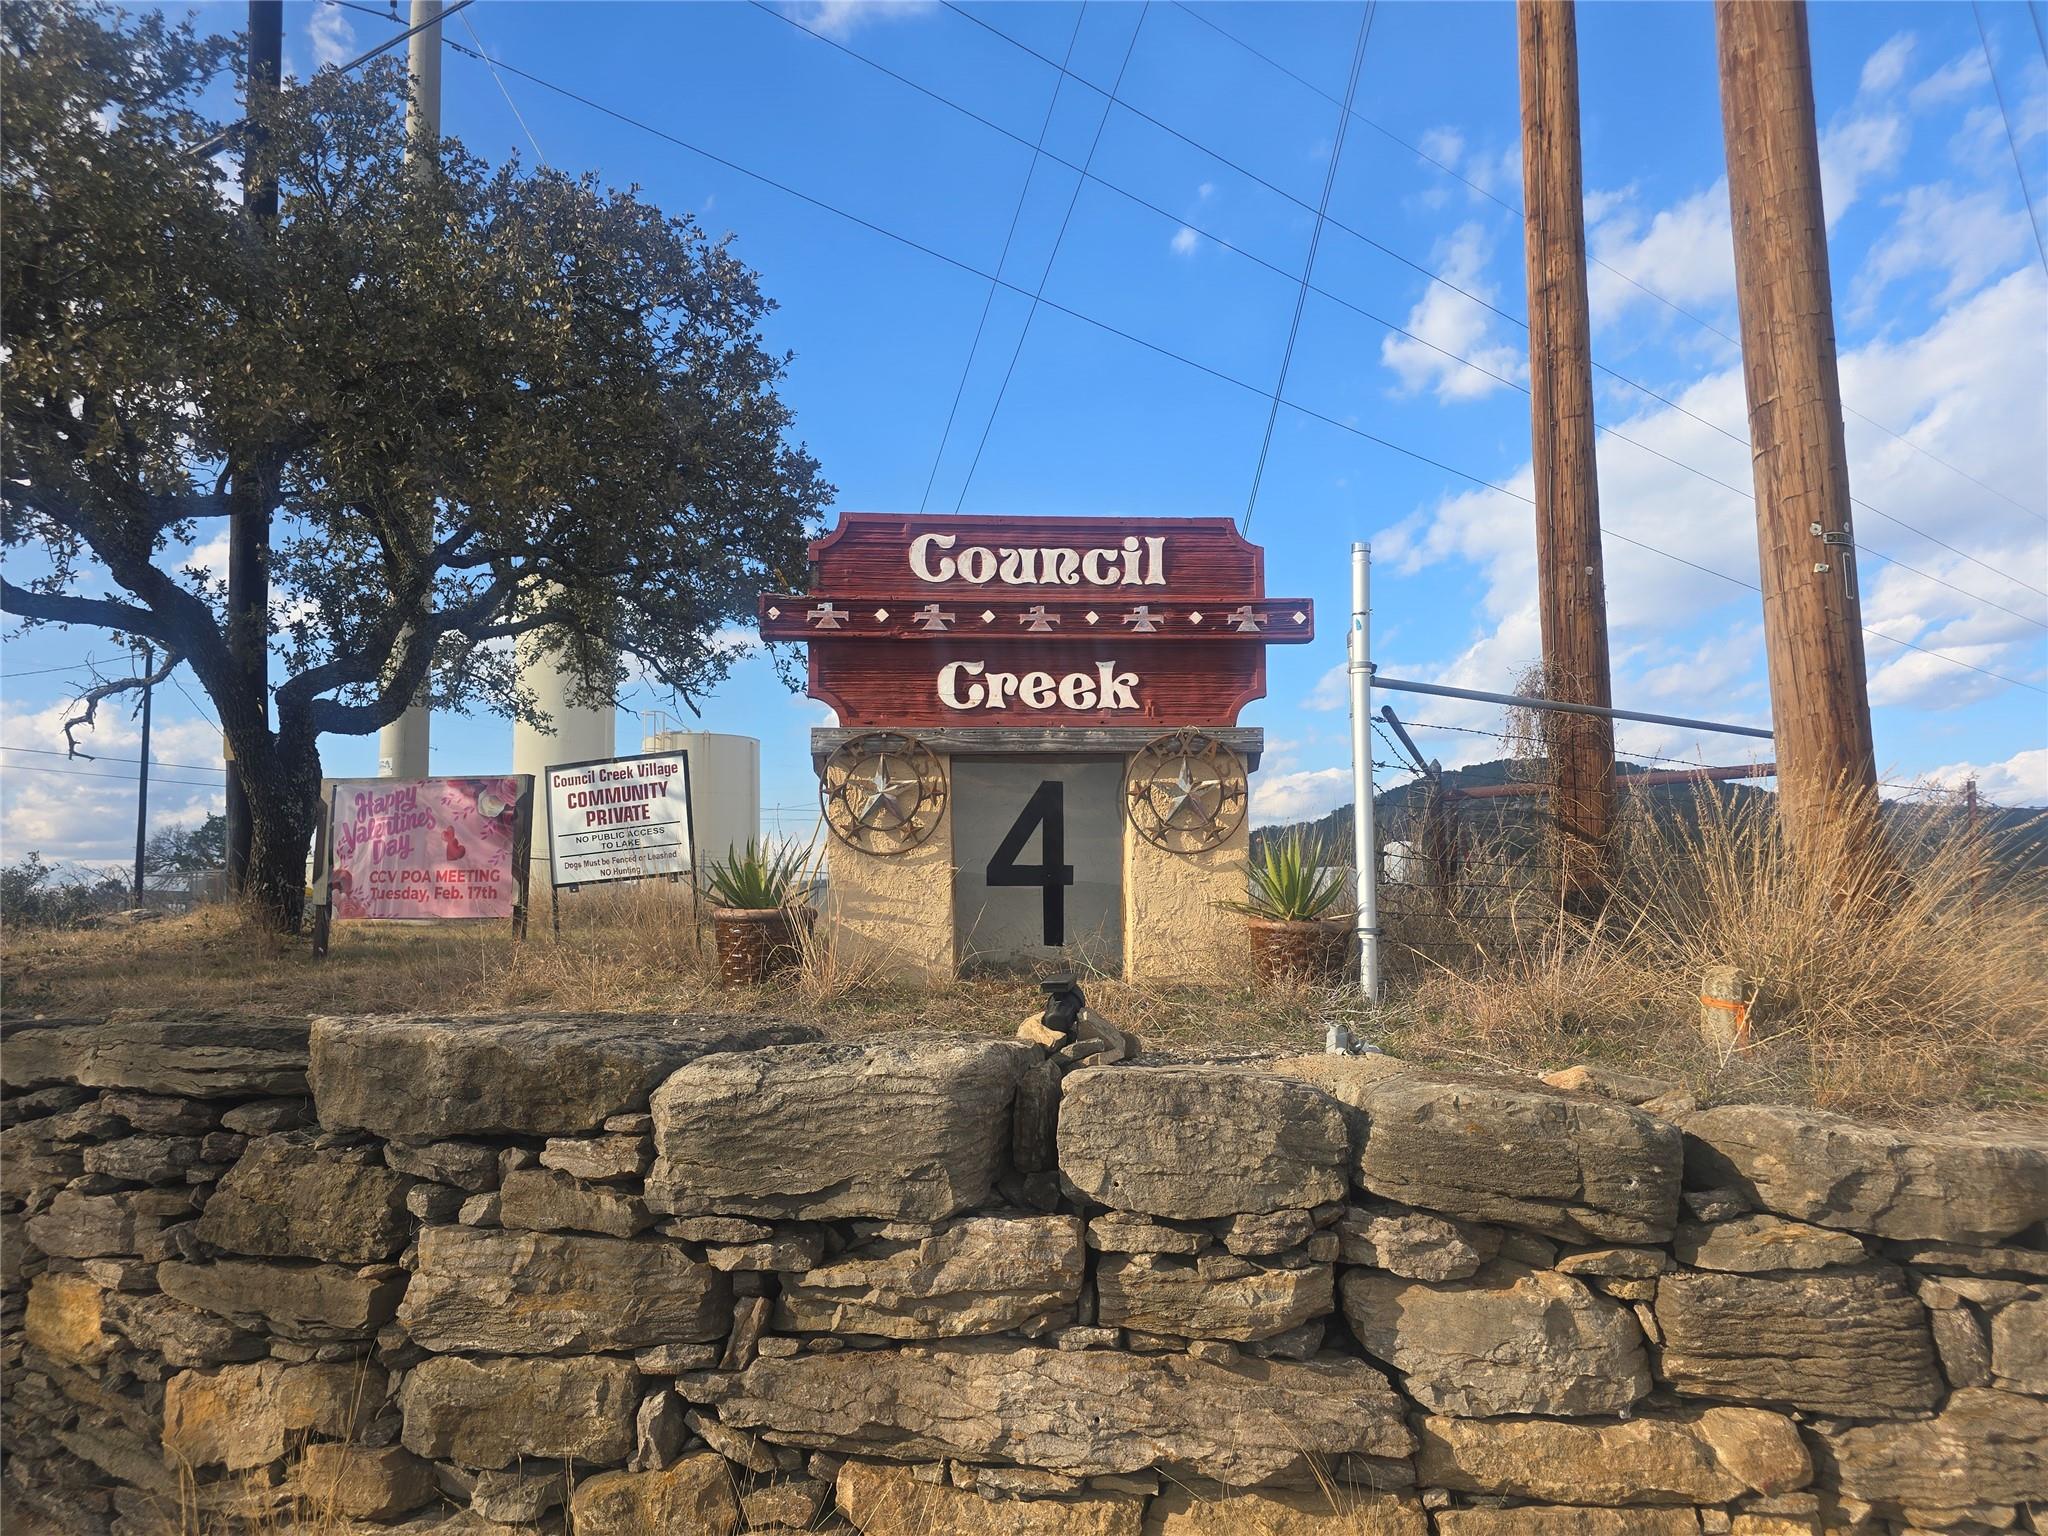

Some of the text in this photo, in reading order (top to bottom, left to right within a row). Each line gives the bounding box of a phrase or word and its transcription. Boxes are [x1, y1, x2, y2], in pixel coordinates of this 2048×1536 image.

[908, 533, 1167, 585] Council
[936, 660, 1140, 710] Creek
[553, 763, 678, 788] Council Creek Village
[355, 786, 418, 823] Happy
[567, 781, 668, 809] COMMUNITY
[586, 804, 650, 827] PRIVATE
[576, 827, 665, 843] NO PUBLIC ACCESS
[616, 839, 640, 848] LAKE
[372, 835, 414, 865] Day
[564, 861, 582, 871] Dogs
[583, 858, 600, 867] Must
[601, 857, 610, 865] be
[612, 853, 636, 864] Fenced
[647, 850, 677, 861] Leashed
[600, 866, 641, 877] NO Hunting
[986, 780, 1074, 947] 4
[369, 869, 500, 884] CCV POA MEETING
[370, 886, 497, 902] Tuesday, Feb. 17th
